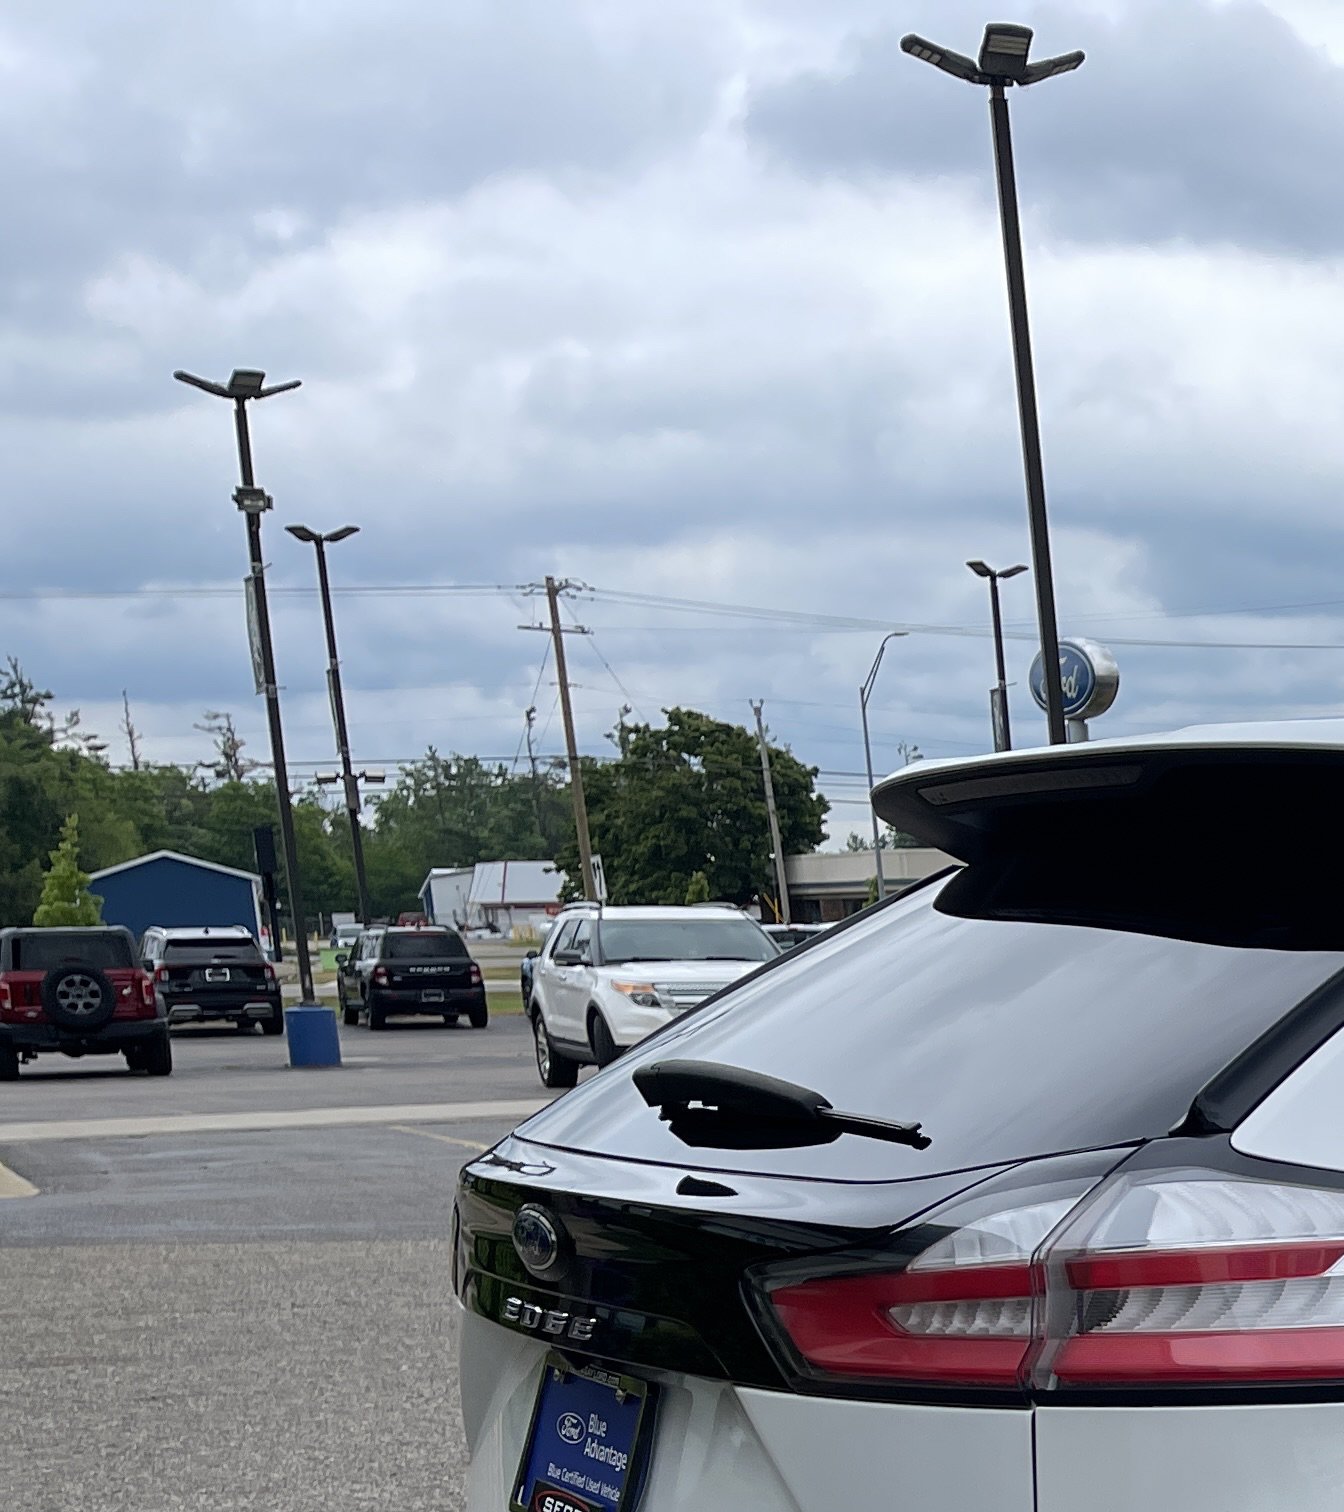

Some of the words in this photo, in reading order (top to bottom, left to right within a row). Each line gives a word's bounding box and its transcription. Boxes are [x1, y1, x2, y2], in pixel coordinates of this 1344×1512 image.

[504, 1296, 598, 1341] EDGE
[561, 1412, 582, 1440] Ford
[587, 1413, 608, 1439] Blue
[583, 1437, 628, 1471] Advantage
[547, 1462, 562, 1480] Blue
[561, 1466, 586, 1490] Certified
[585, 1475, 601, 1495] Used
[600, 1482, 621, 1502] Vehicle
